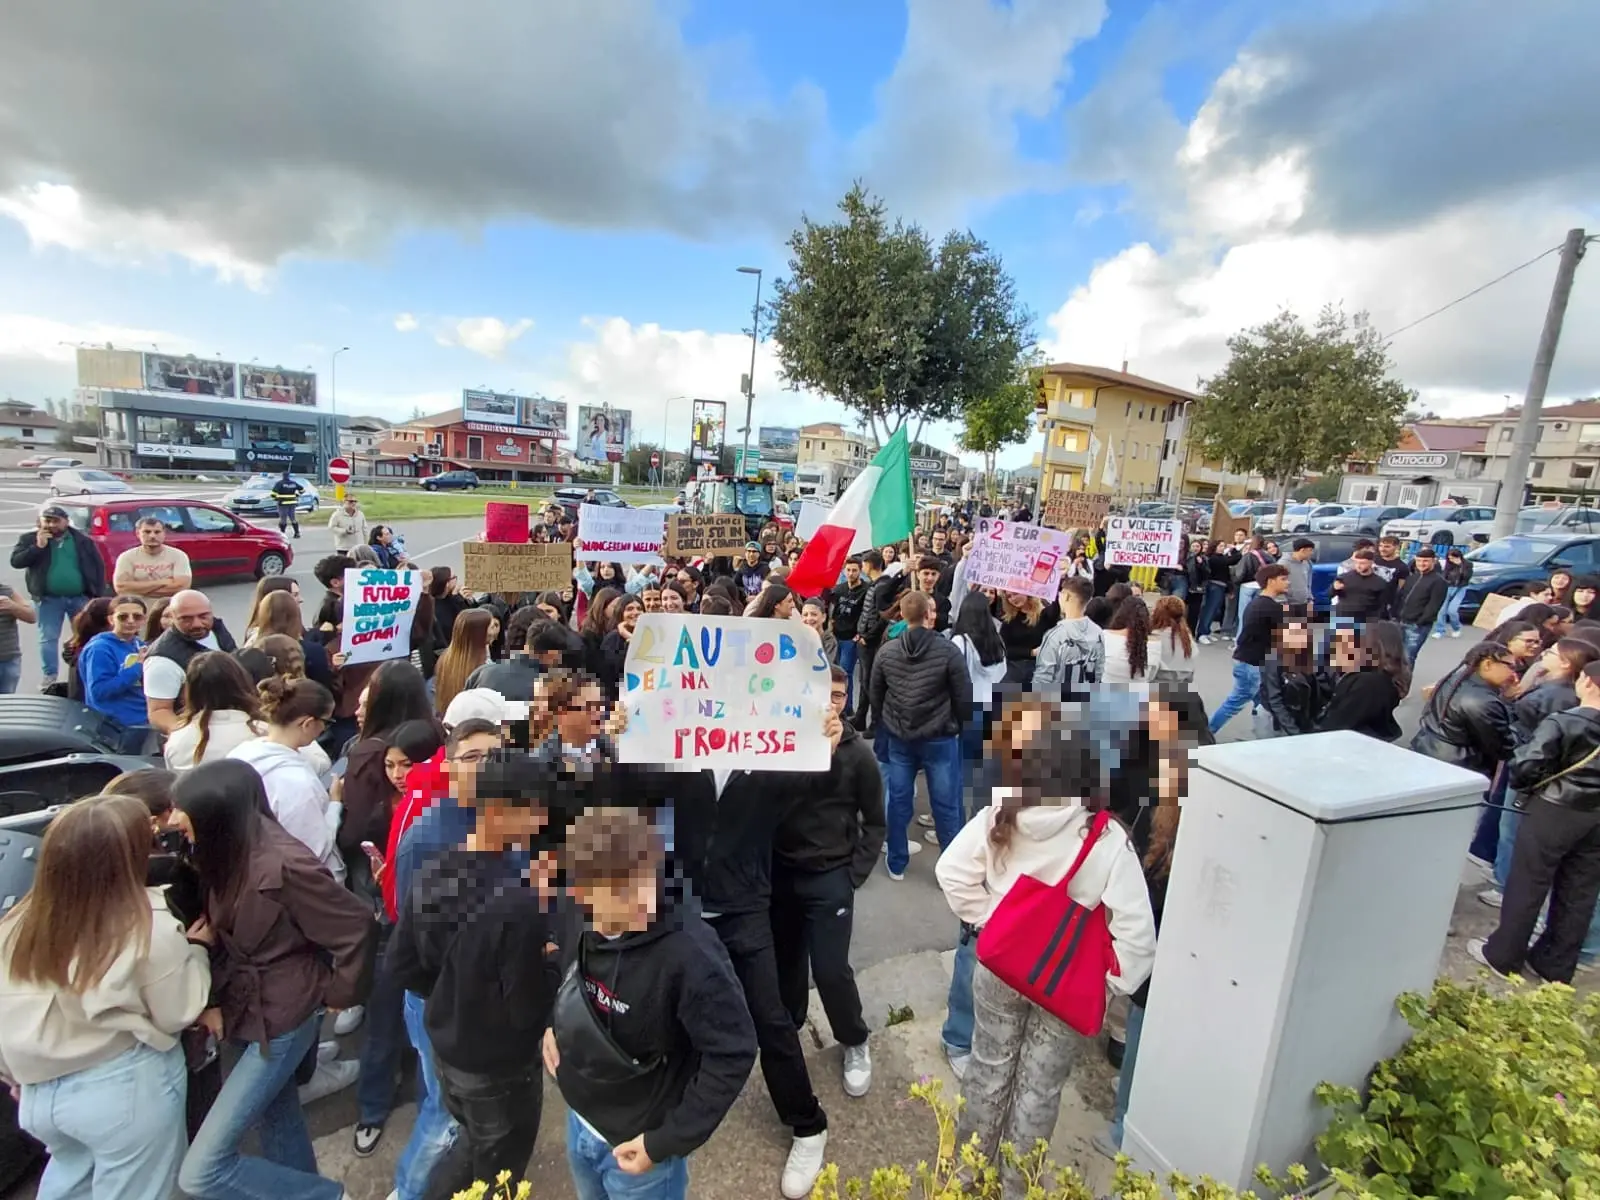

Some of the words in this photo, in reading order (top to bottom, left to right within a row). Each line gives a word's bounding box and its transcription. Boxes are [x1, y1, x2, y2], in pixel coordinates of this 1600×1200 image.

[257, 453, 293, 461] RENAULT
[980, 520, 989, 533] A
[990, 521, 1004, 540] 2
[1111, 518, 1122, 529] CI
[1128, 519, 1173, 532] VOLETE
[1121, 530, 1173, 542] IGNORANTI
[1107, 541, 1121, 550] PER
[1126, 541, 1160, 553] AVERCI
[972, 550, 1011, 565] ALMENO
[363, 586, 410, 603] FUTURO
[632, 624, 828, 671] L'AUTOBS
[626, 668, 672, 692] DEL
[661, 699, 758, 723] BNZA
[674, 726, 796, 759] PROMESSE
